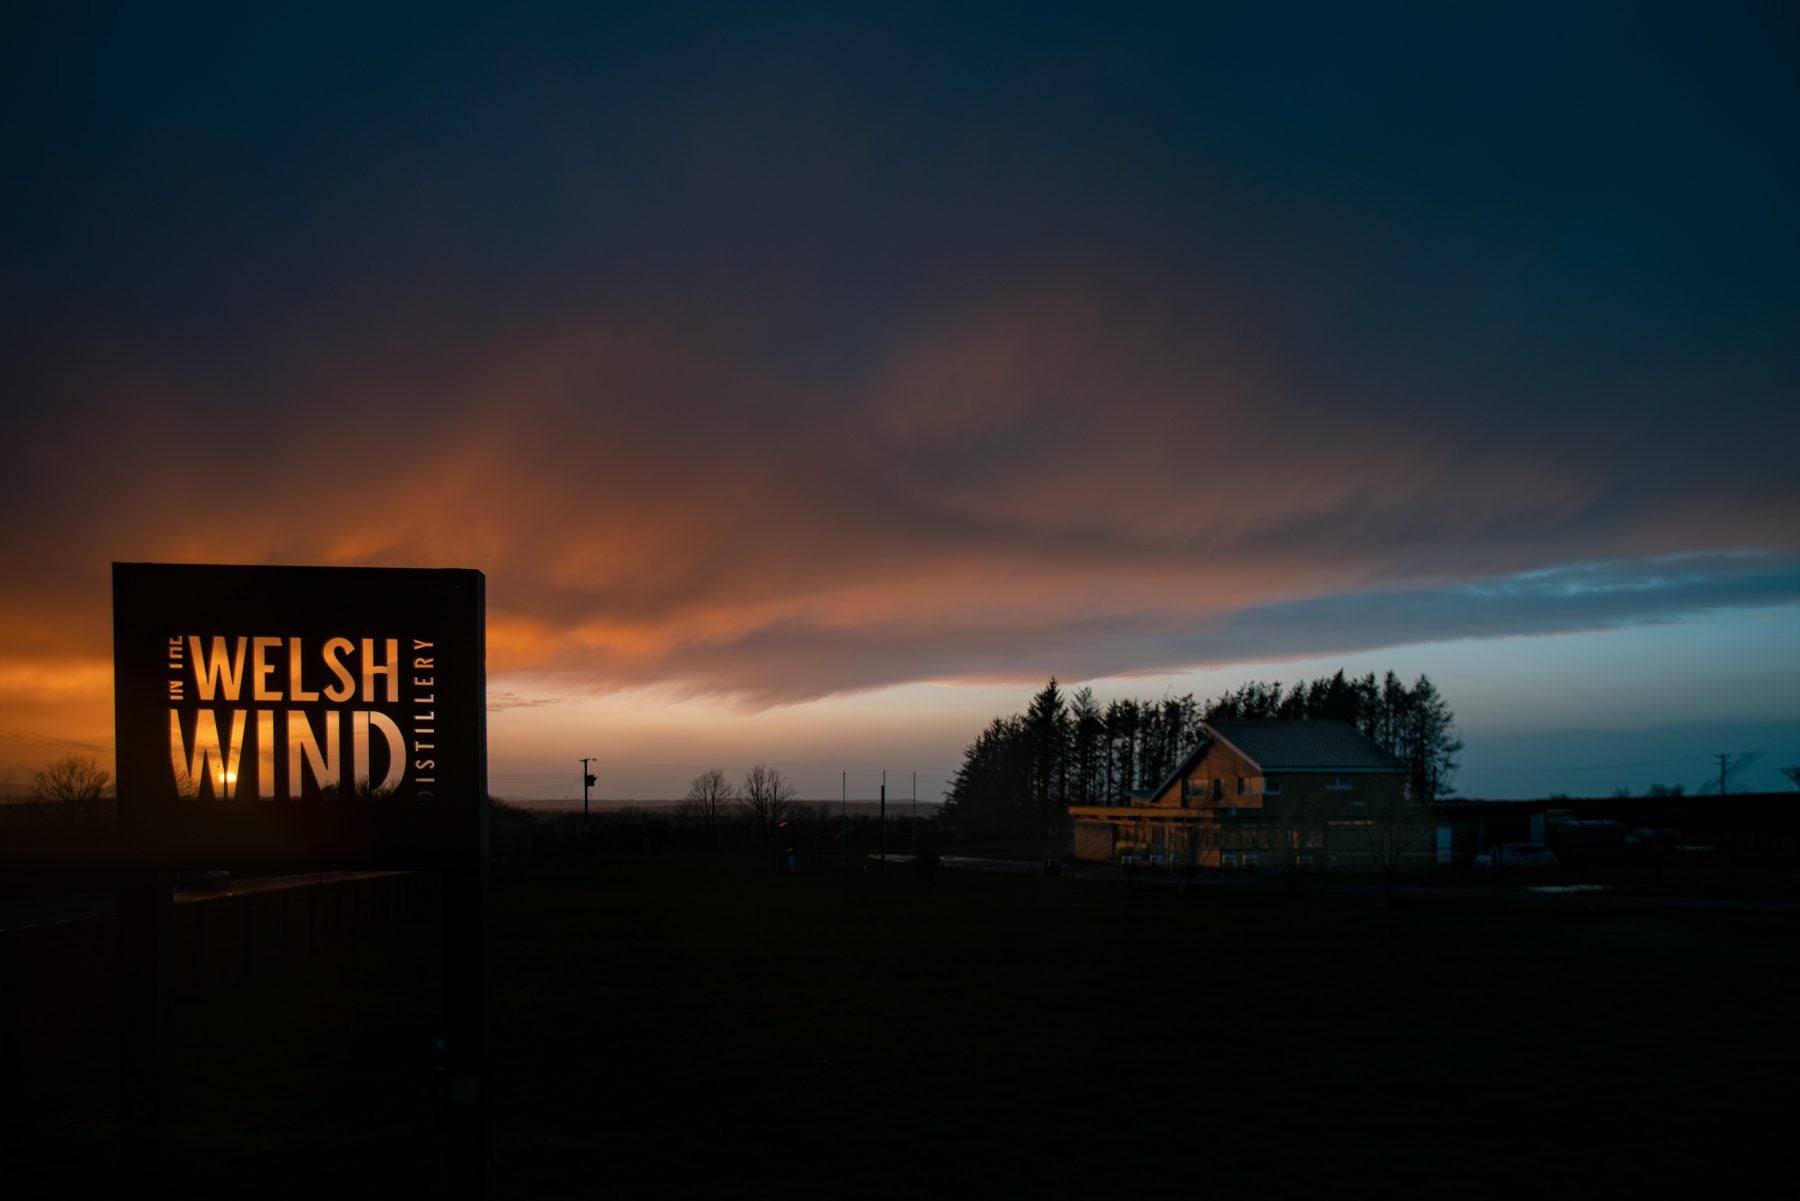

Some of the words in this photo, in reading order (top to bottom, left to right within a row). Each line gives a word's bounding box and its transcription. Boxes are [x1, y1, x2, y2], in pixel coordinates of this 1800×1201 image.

[168, 680, 184, 701] IN
[188, 635, 399, 702] WELSH
[169, 708, 407, 801] WIND
[414, 639, 435, 803] DISTILLERY
